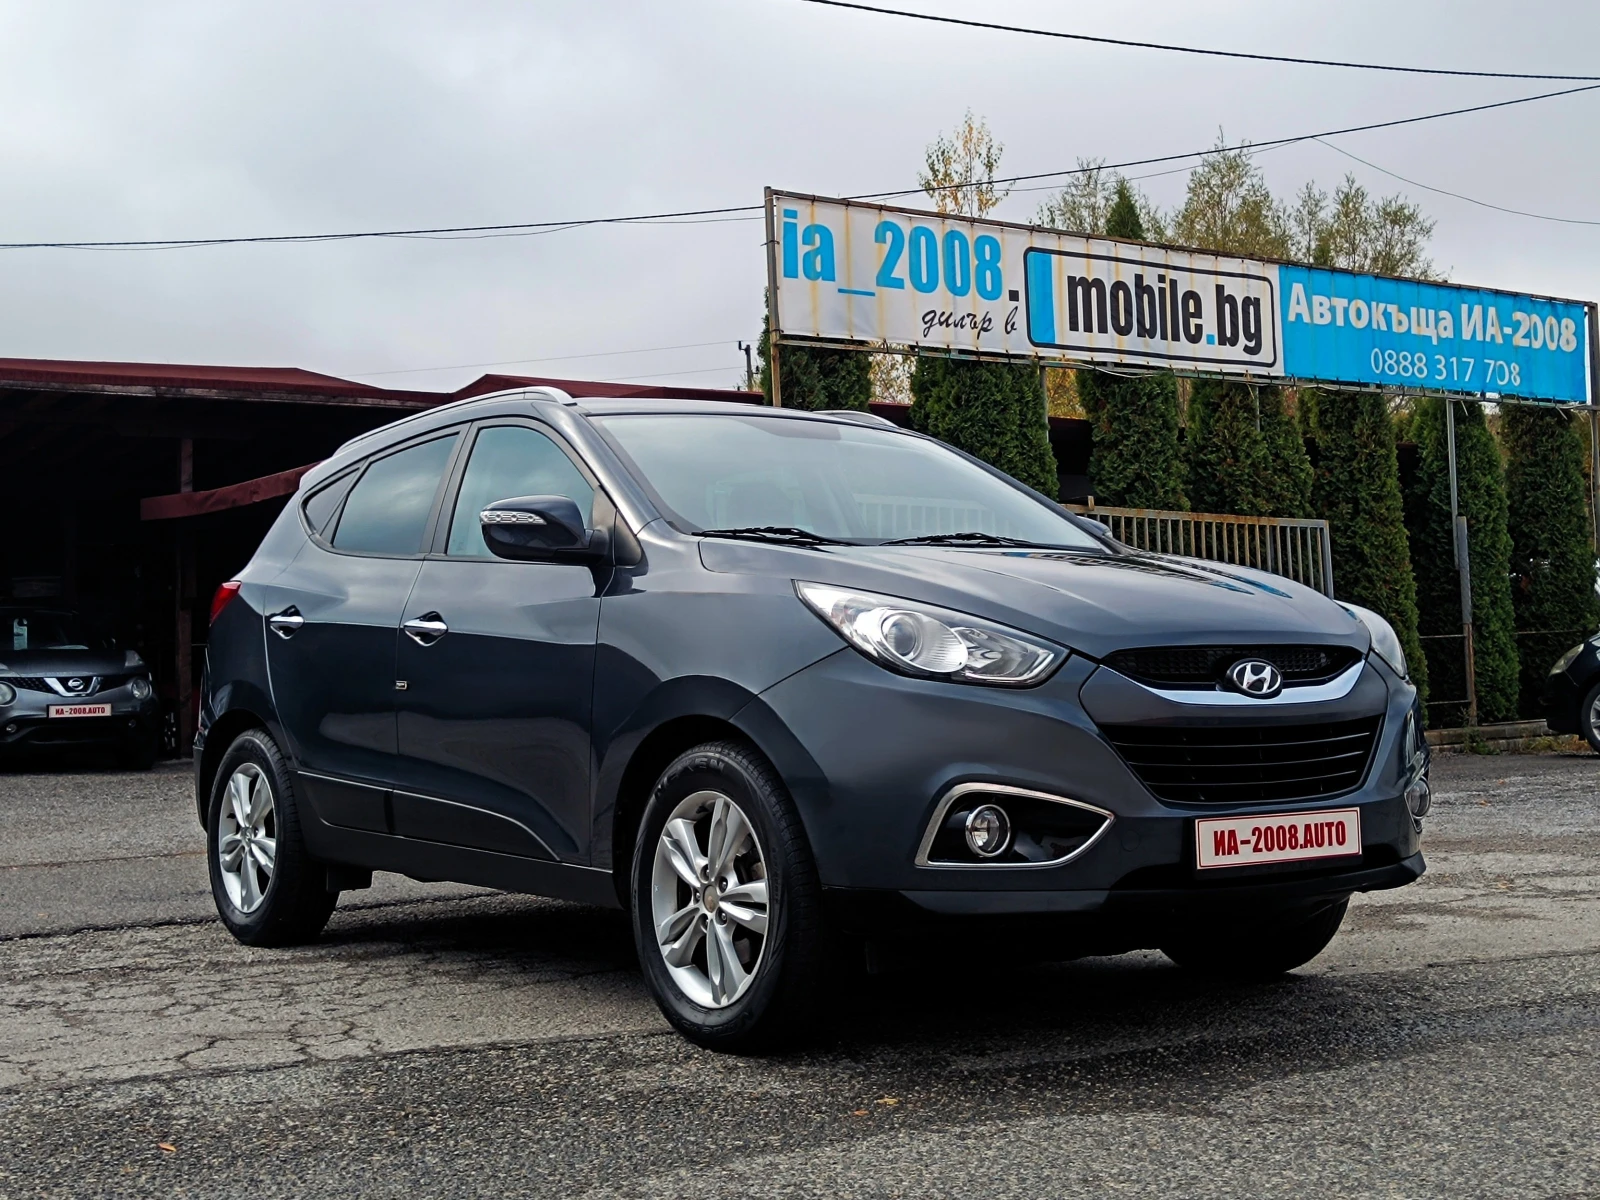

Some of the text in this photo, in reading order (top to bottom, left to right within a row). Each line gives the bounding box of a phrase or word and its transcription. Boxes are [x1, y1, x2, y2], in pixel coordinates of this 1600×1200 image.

[1067, 273, 1263, 356] mobile.bg
[1288, 283, 1577, 352] Автокъща ИА-2008
[1371, 348, 1521, 386] 0888 317 708
